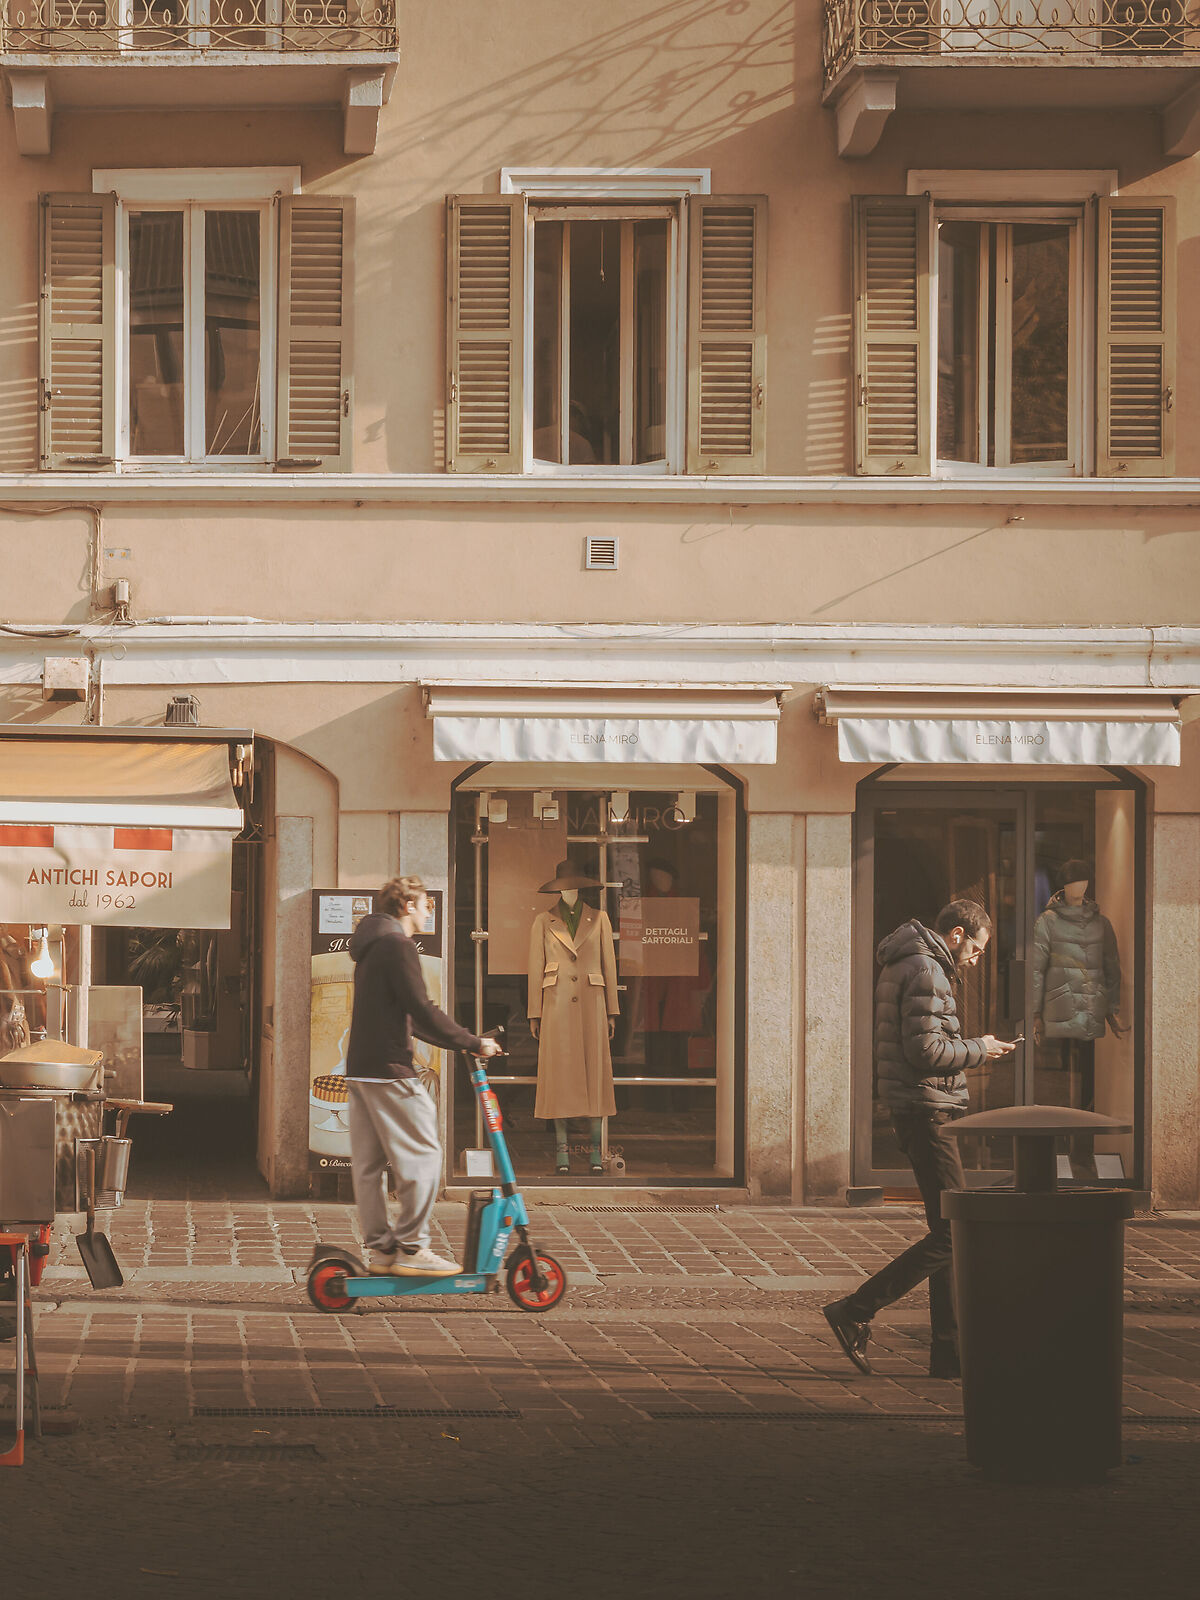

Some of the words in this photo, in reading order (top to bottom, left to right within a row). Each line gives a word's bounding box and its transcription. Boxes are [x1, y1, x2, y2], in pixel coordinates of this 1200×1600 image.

[570, 735, 605, 745] ELENA
[975, 734, 1011, 745] ELENA
[26, 867, 98, 886] ANTICHI
[105, 870, 173, 889] SAPORI
[68, 888, 88, 908] dal
[95, 893, 136, 910] 1962
[645, 927, 688, 936] DETTAGLI
[641, 936, 693, 945] SARTORIALI
